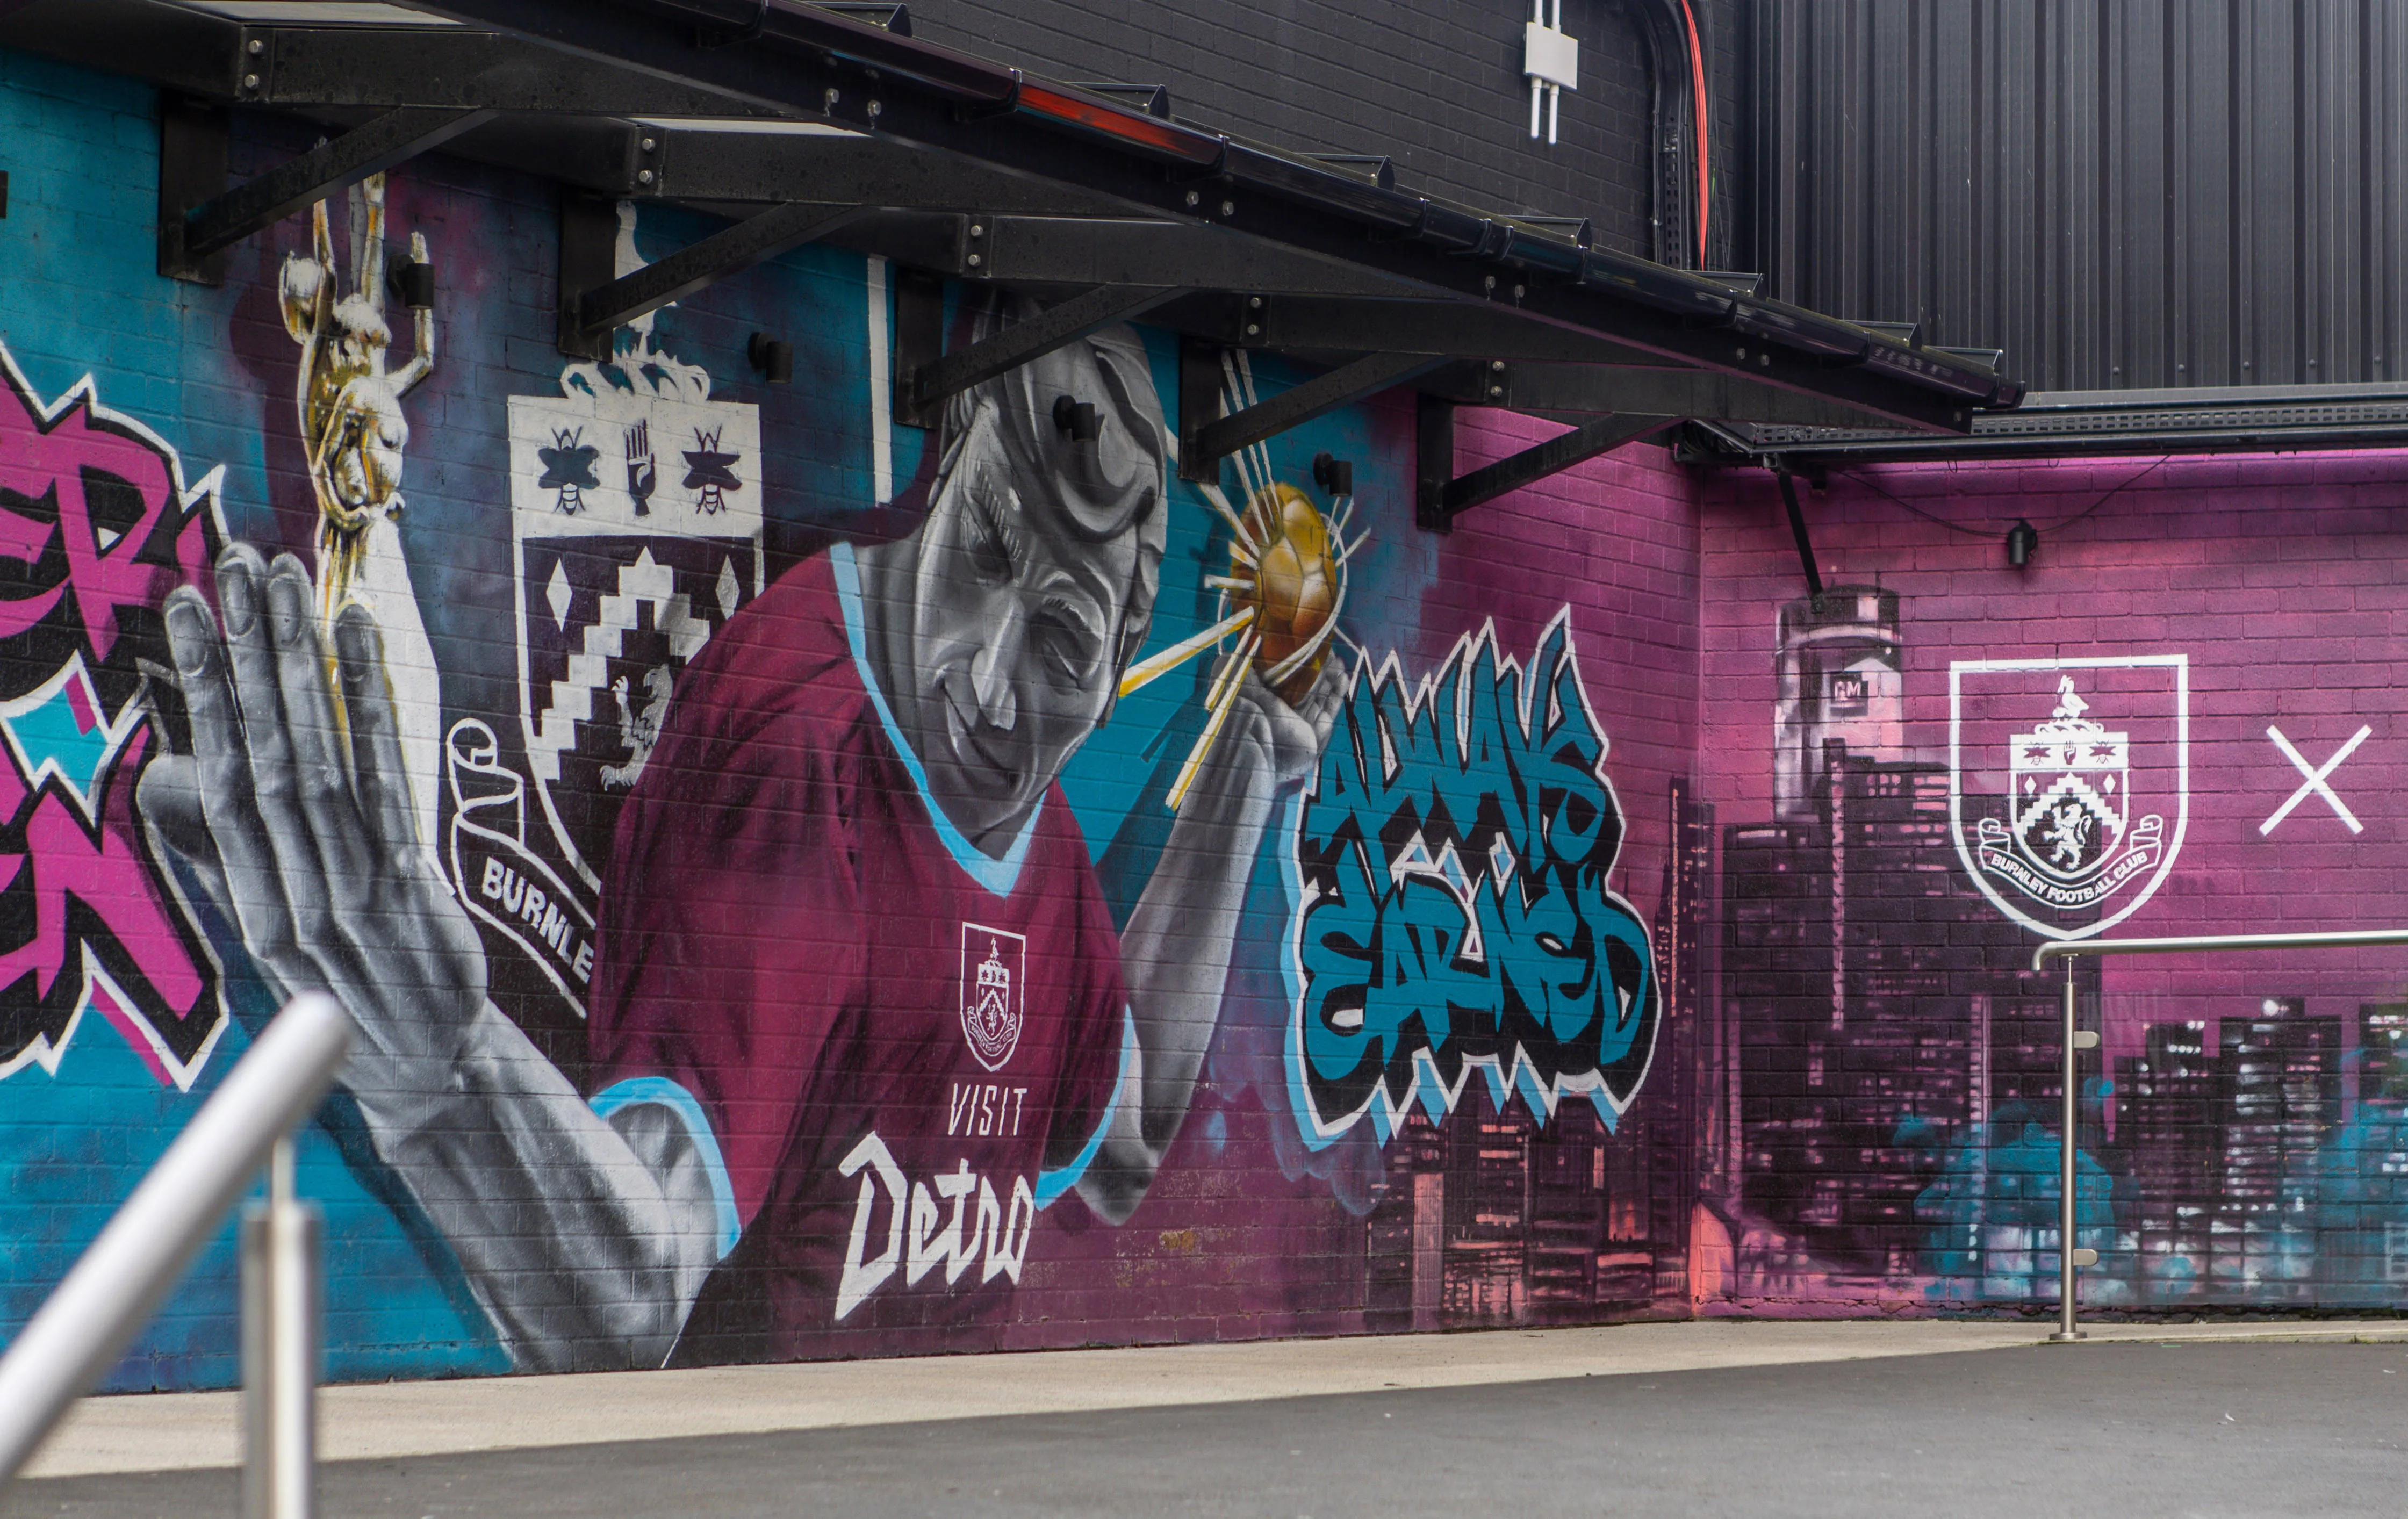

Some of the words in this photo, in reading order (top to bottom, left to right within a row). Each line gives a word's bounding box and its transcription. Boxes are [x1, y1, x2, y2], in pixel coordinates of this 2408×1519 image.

[1306, 628, 1607, 872] ALWAYS
[1991, 853, 2047, 895] BURNLEY
[2046, 877, 2115, 902] FOOTBALL
[2114, 851, 2148, 880] CLUB
[1302, 839, 1650, 1080] EARNED
[947, 1082, 1027, 1136] VISIT
